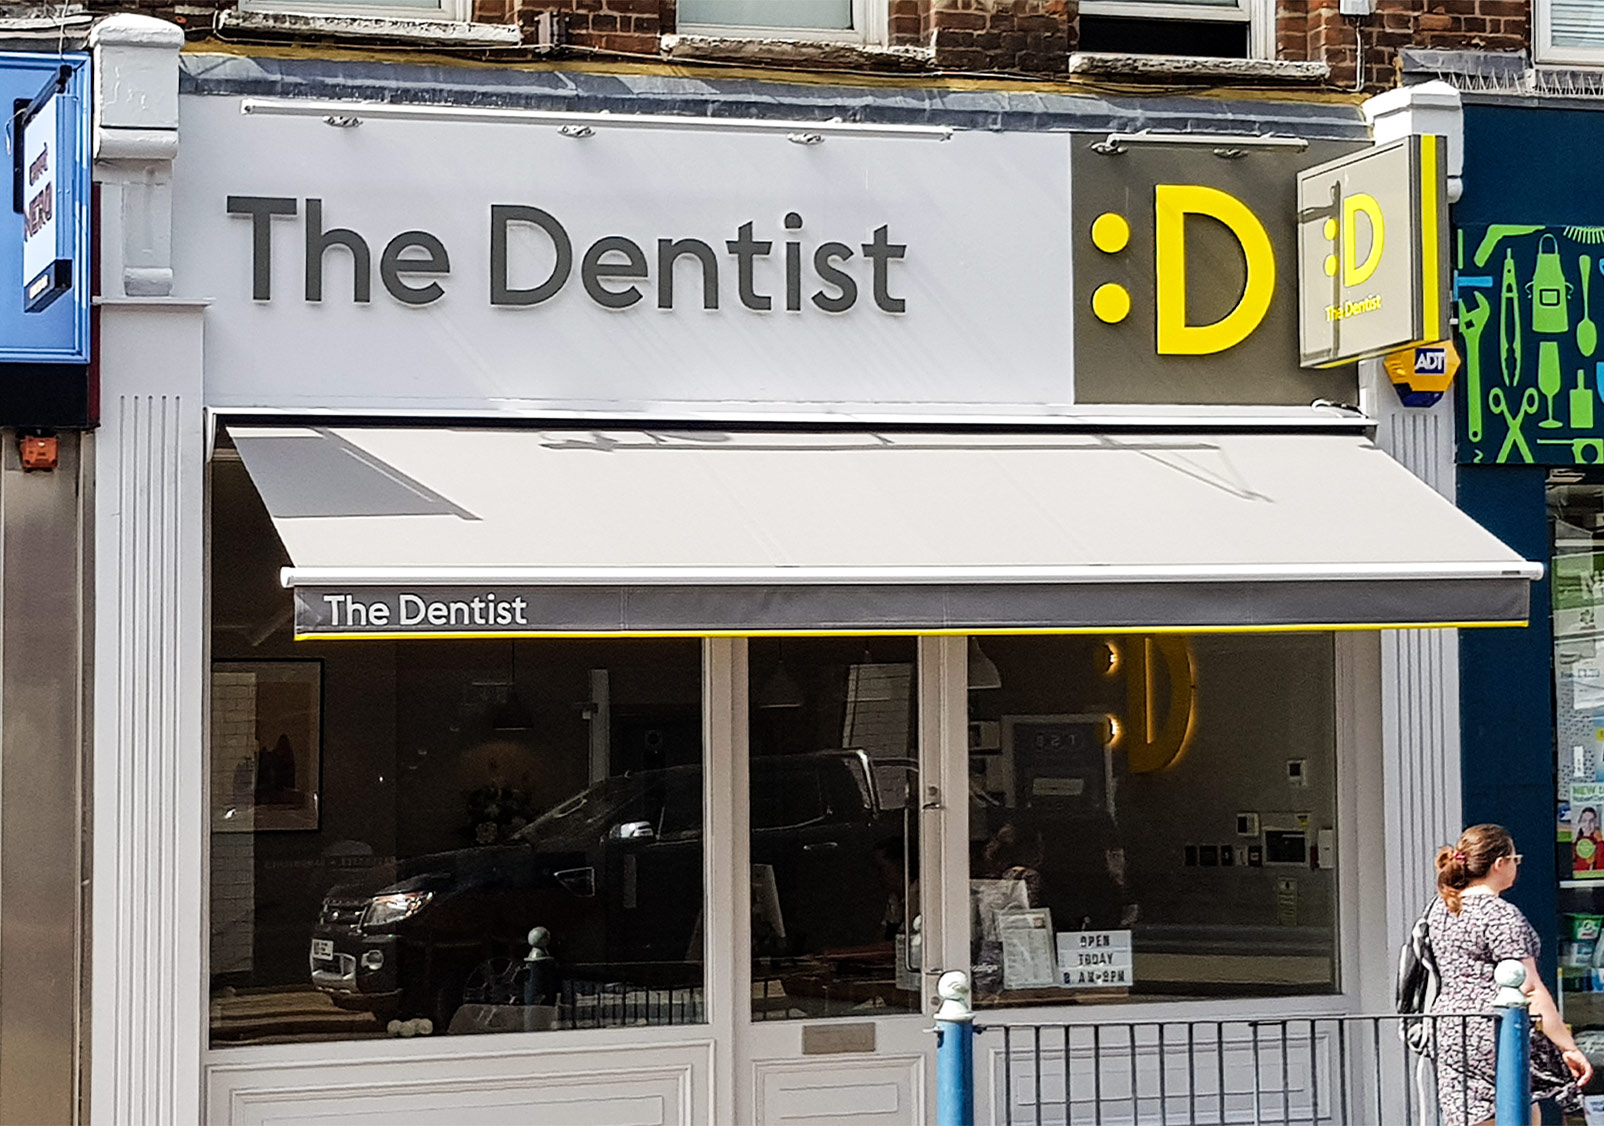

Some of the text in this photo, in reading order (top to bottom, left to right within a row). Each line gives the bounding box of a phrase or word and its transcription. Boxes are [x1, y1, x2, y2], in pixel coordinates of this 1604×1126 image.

[227, 195, 907, 313] The Dentist
[1325, 294, 1382, 322] The Dentist
[1415, 351, 1446, 371] ADT
[323, 593, 528, 626] The Dentist
[1080, 935, 1110, 948] OPEN
[1078, 953, 1113, 966] TODAY
